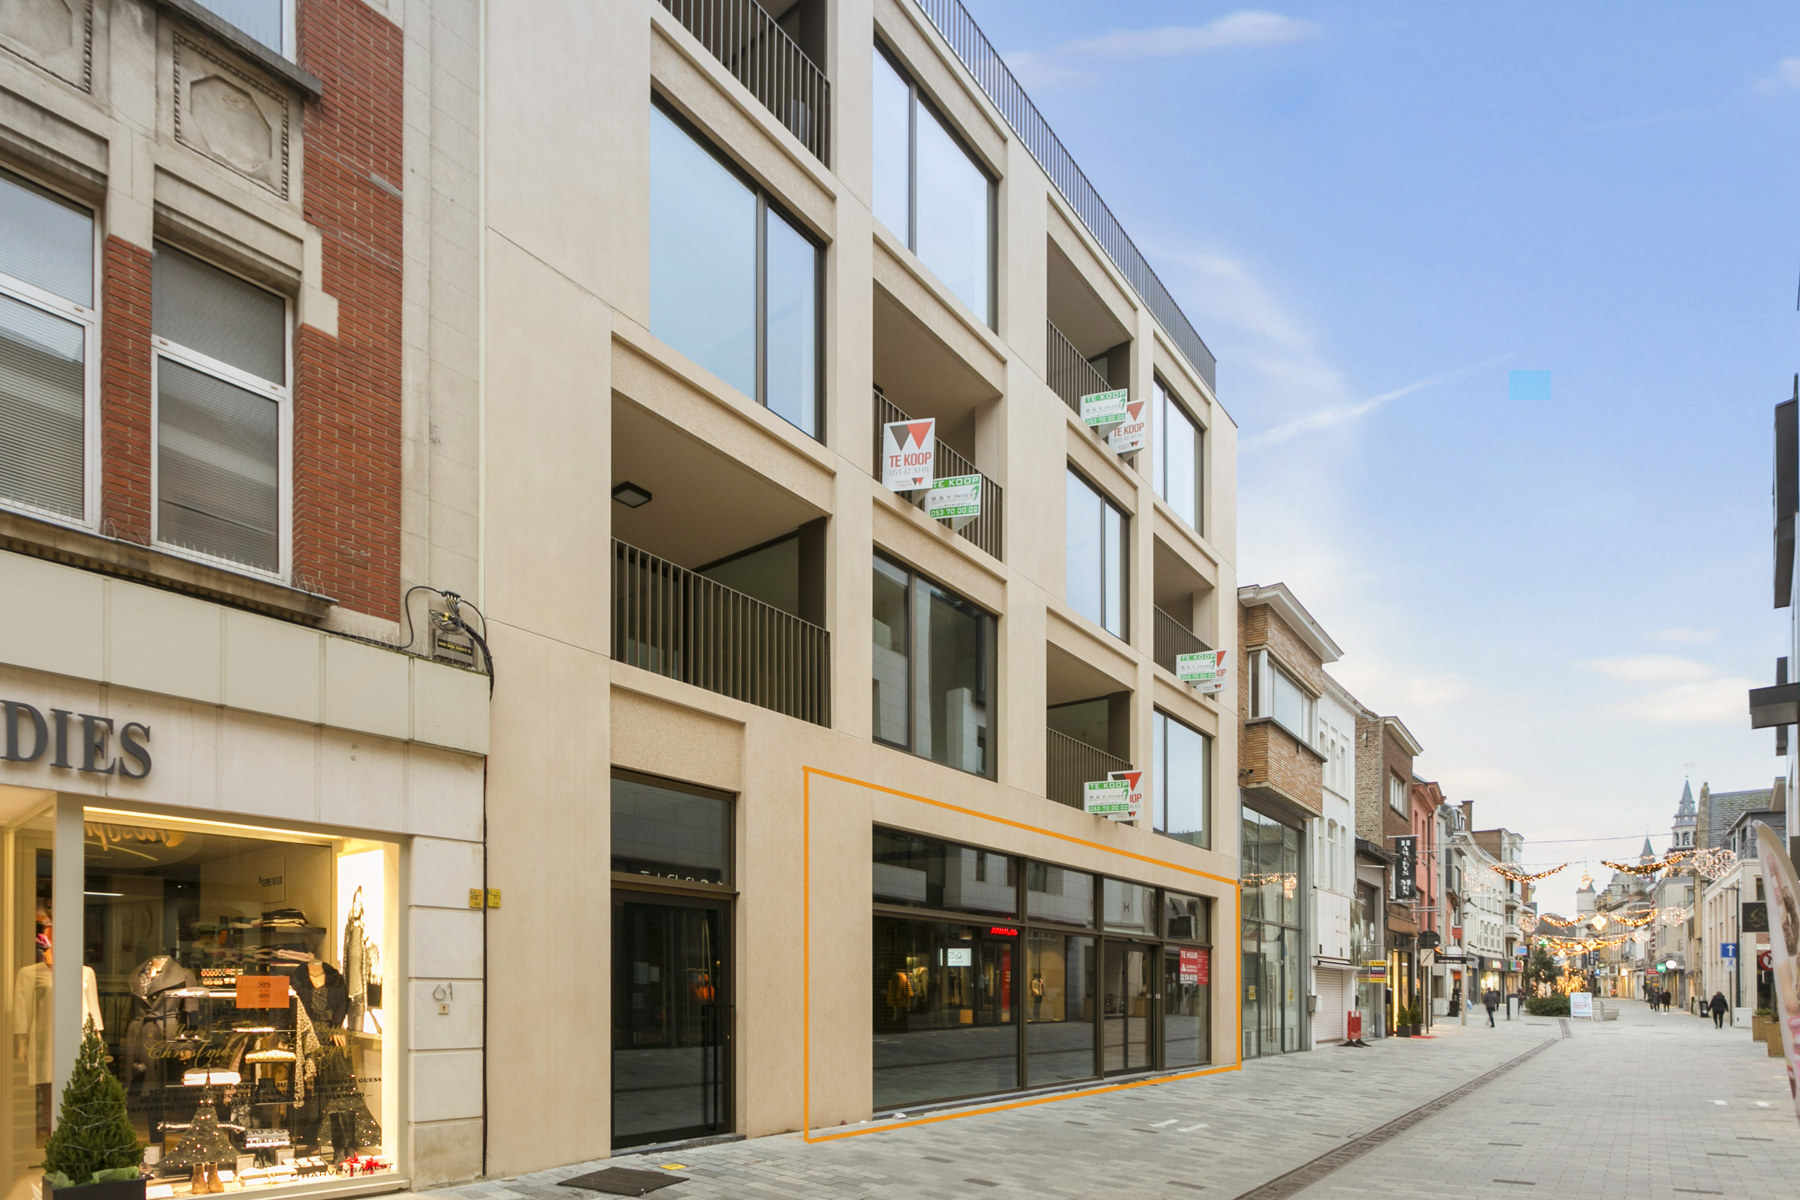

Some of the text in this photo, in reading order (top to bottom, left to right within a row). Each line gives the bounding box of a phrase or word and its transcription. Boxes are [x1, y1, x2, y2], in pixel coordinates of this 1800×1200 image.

[1101, 390, 1126, 400] KOOP
[1113, 422, 1145, 437] TE KOOP
[889, 452, 932, 468] TE KOOP
[932, 477, 979, 489] TE KOOP
[946, 508, 956, 516] 70
[0, 700, 152, 780] DIES
[1103, 781, 1129, 789] KOOP
